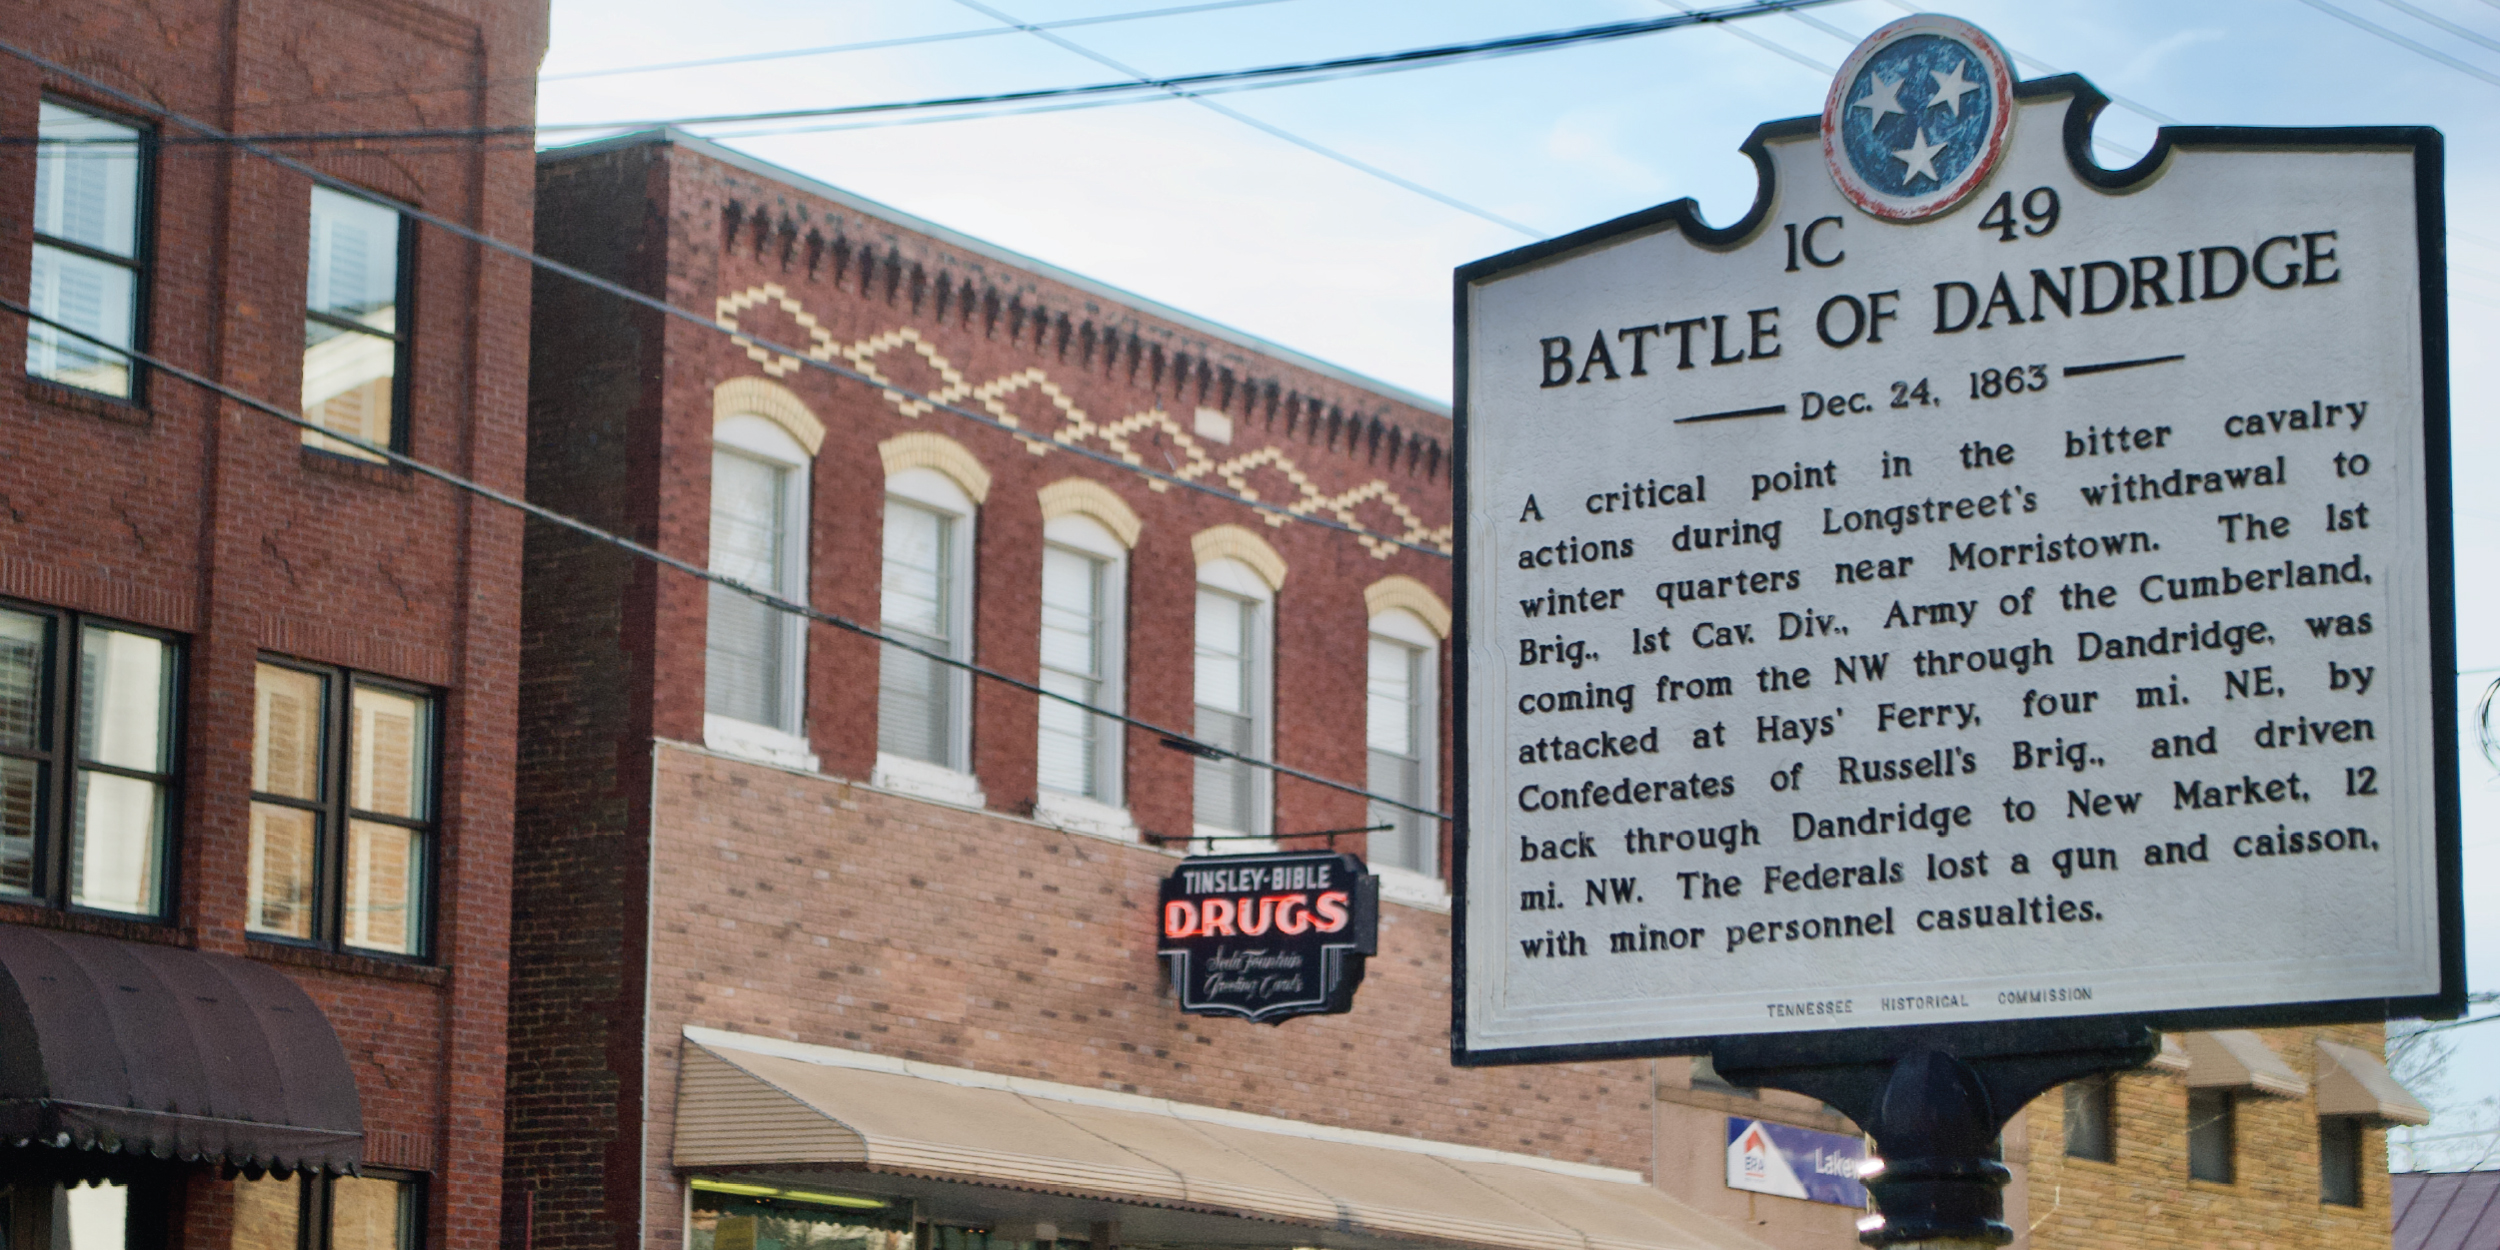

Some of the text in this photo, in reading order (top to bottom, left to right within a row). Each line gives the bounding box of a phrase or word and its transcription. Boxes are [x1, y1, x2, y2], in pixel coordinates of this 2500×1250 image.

[1977, 185, 2062, 244] 49
[1538, 229, 2342, 390] BATTLE OF DANDRIDGE
[1800, 390, 1874, 422] Dec.
[1969, 363, 2049, 401] 1863
[1518, 399, 2370, 524] A critical point in the bitter cavalry
[1517, 451, 2372, 571] actions during Longstreet's withdrawal to
[1518, 586, 1626, 619] winter
[1655, 569, 1801, 610] quarters
[1834, 556, 1915, 585] near
[1947, 531, 2161, 573] Morristown.
[2217, 512, 2291, 544] The
[1691, 621, 1755, 650] Cav.
[1882, 599, 1980, 630] Army
[1998, 585, 2036, 617] of
[2058, 582, 2118, 612] the
[2139, 553, 2373, 605] Cumberland,
[1517, 611, 2374, 716] coming from the NW through Dandridge, was
[1518, 660, 2376, 766] attacked at Hays' Ferry, four mi. NE, by
[1517, 772, 1736, 814] Confederates
[1769, 761, 1805, 793] of
[1837, 745, 1978, 786] Russell's
[2150, 725, 2219, 760] and
[2253, 715, 2376, 750] driven
[1519, 830, 1598, 863] back
[1623, 818, 1762, 856] through
[1791, 801, 1973, 843] Dandridge
[2001, 795, 2037, 824] to
[2066, 787, 2144, 820] New
[2344, 765, 2379, 798] 12
[1165, 891, 1349, 938] DRUGS
[1183, 865, 1332, 894] TINSLEY-BIBLE
[1519, 823, 2380, 912] mi. NW. The Federals lost a gun and caisson,
[1519, 893, 2104, 960] with minor personnel casualties.
[1766, 987, 2093, 1018] TENNESSEE HISTORICAL COMMISSION
[1744, 1156, 1765, 1172] ERA
